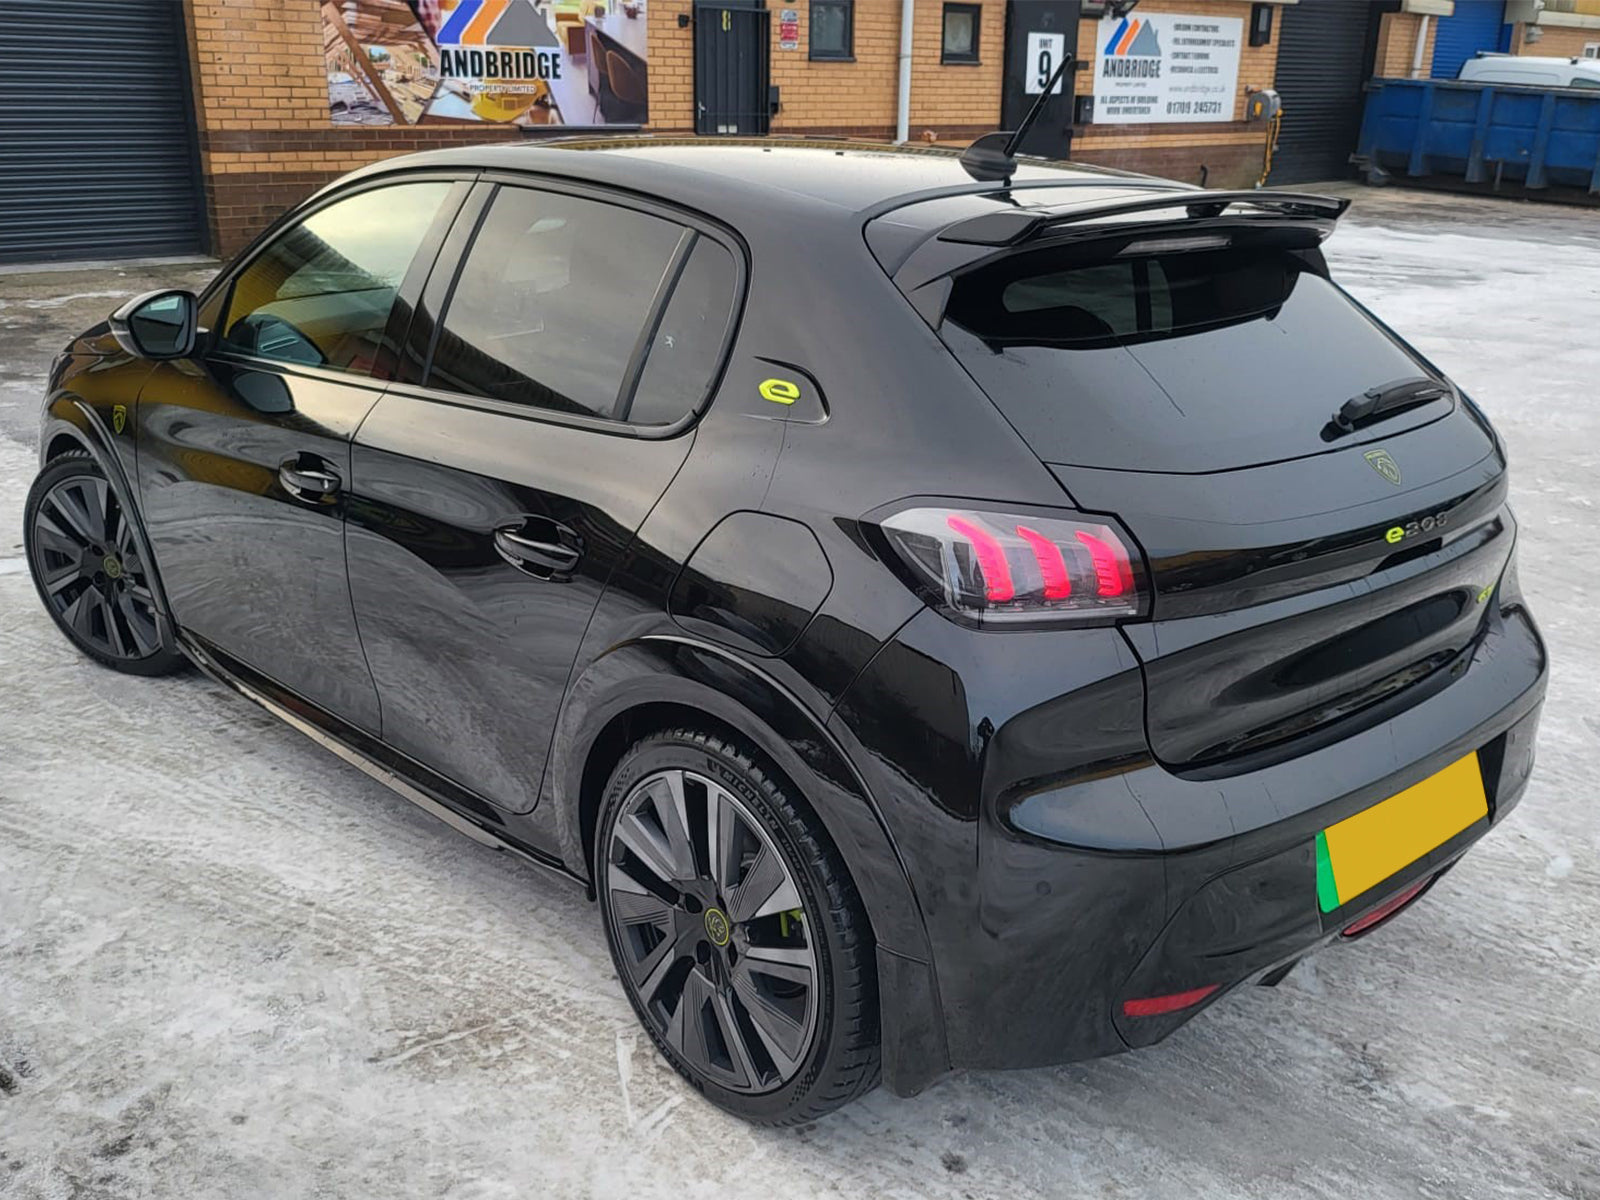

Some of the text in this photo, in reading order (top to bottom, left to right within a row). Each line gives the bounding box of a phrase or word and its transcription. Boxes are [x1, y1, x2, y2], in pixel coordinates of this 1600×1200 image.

[440, 49, 562, 80] ANDBRIDGE
[1038, 50, 1052, 89] 9
[1102, 58, 1161, 78] ANDBRIDGE
[469, 84, 536, 94] PROPERTY LIMITED
[1166, 101, 1191, 114] 01709
[758, 378, 801, 405] e
[722, 769, 779, 831] MICHELIN
